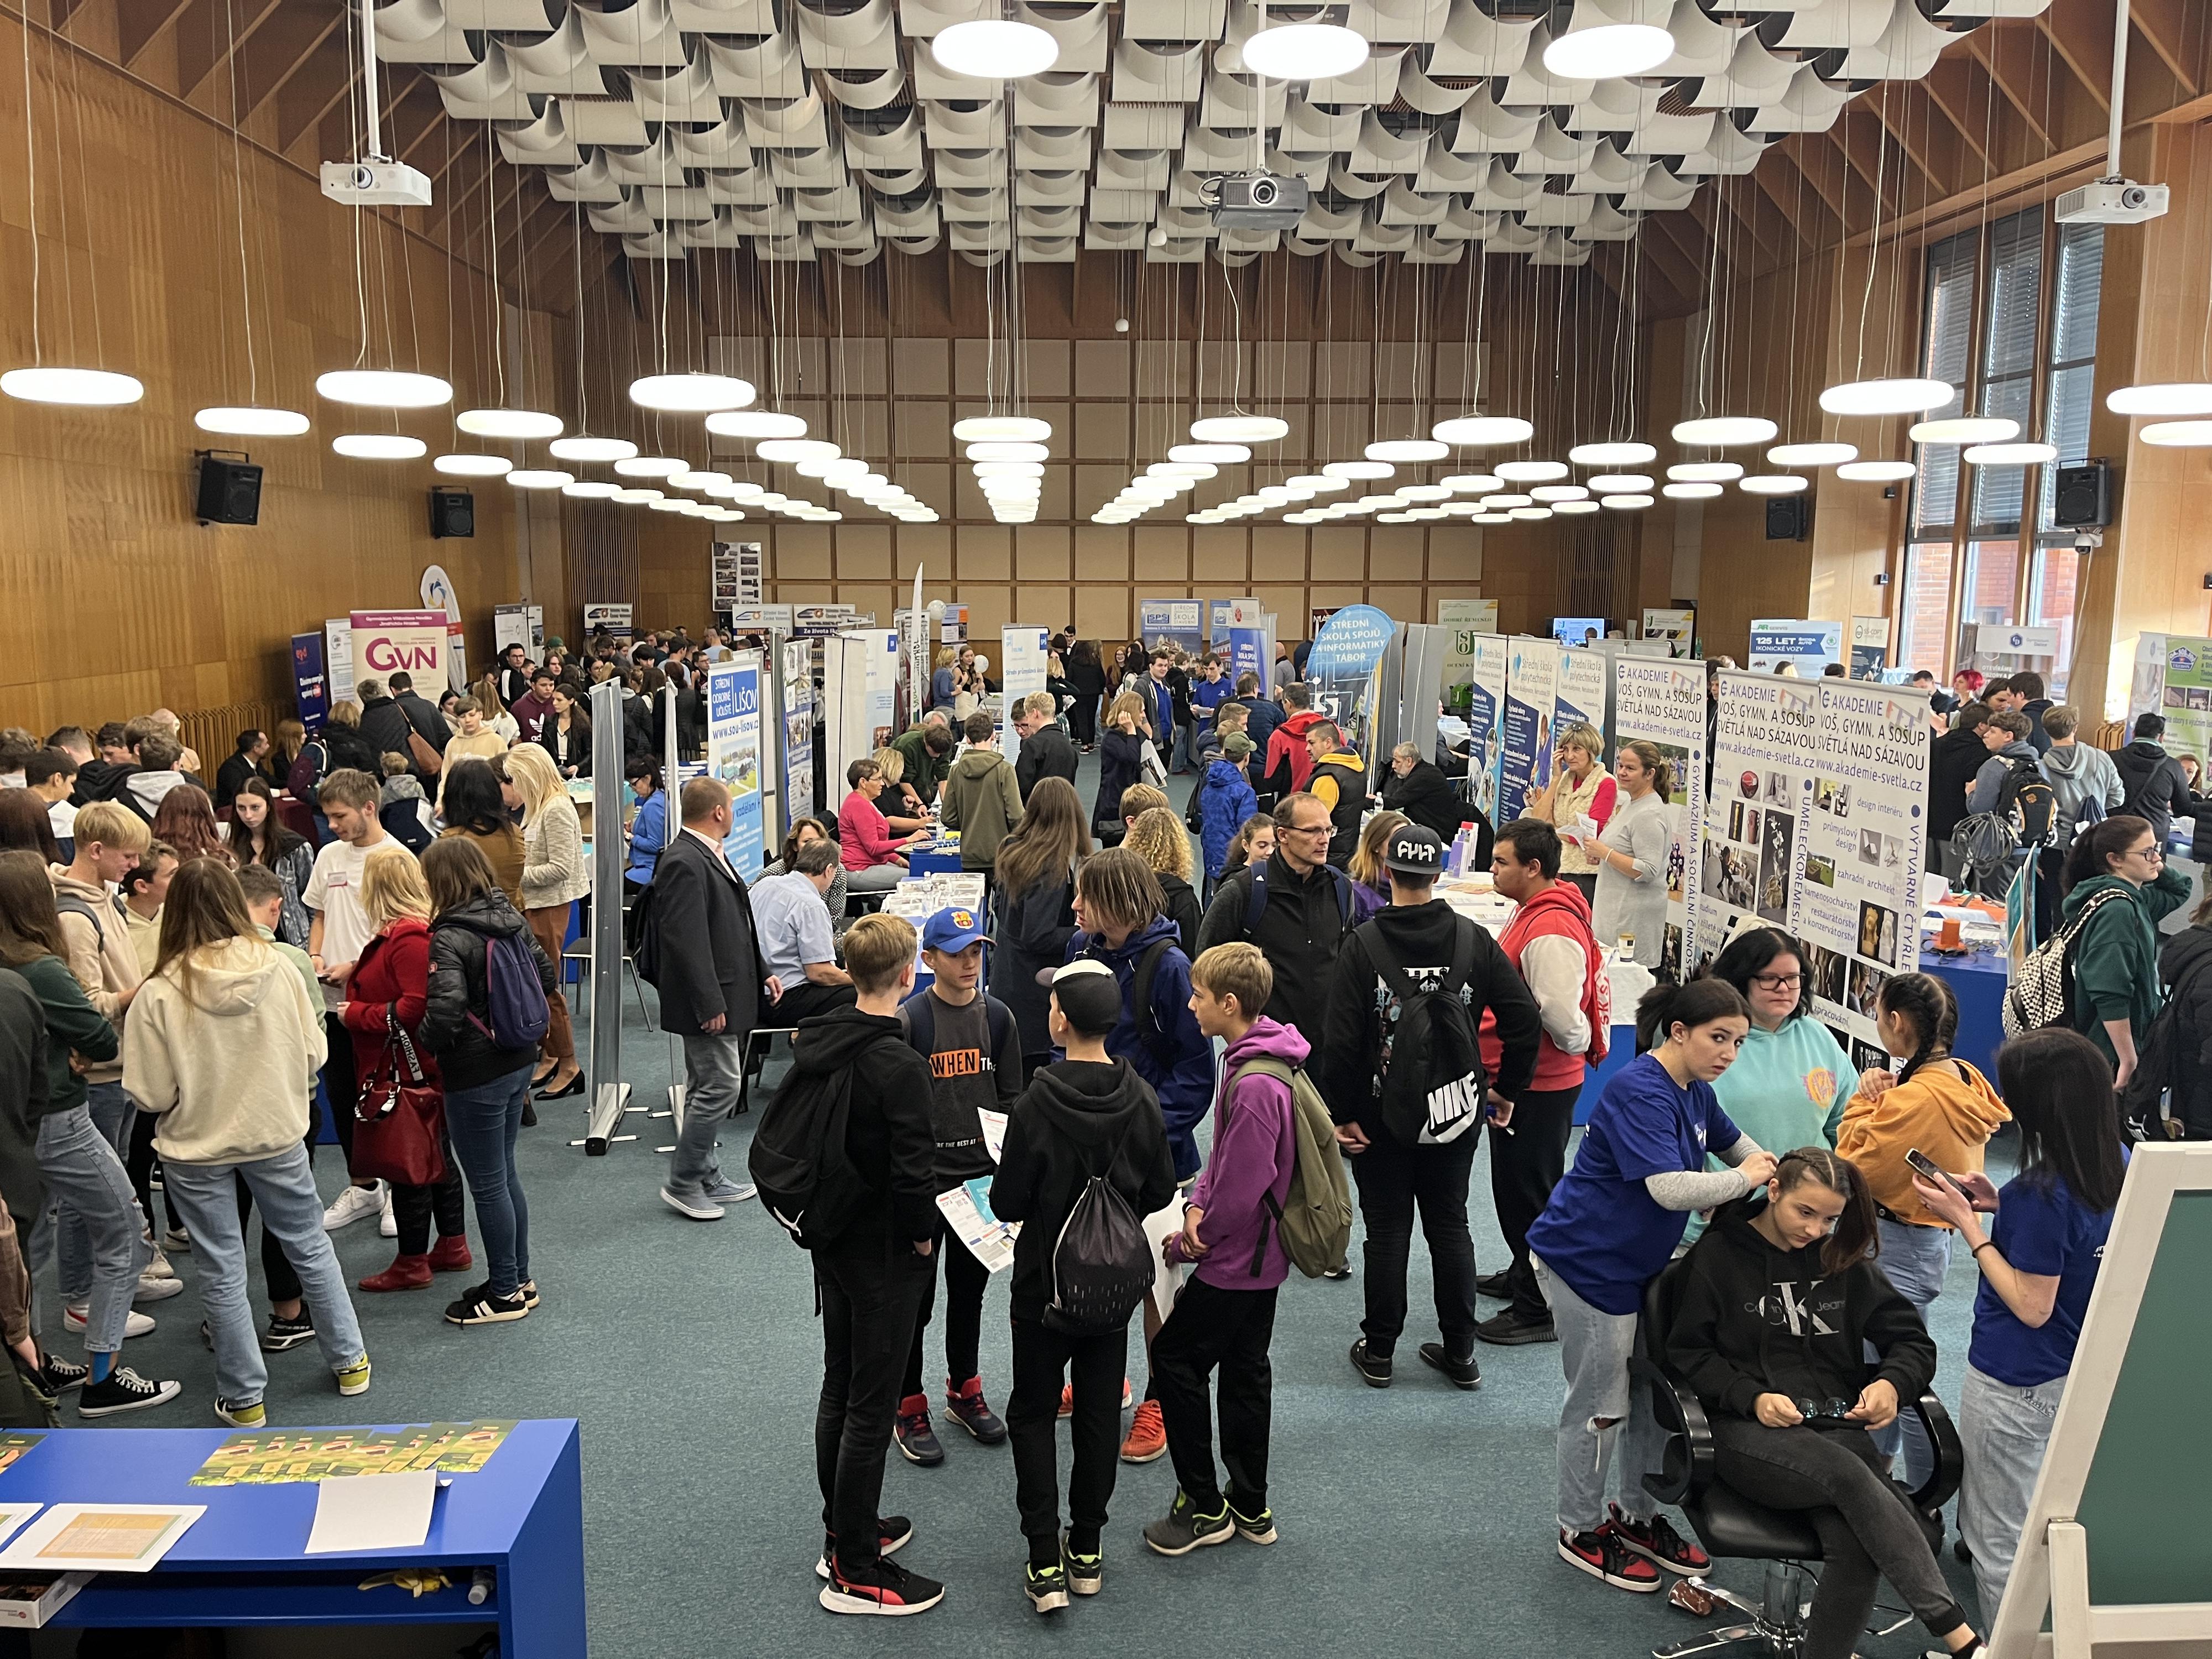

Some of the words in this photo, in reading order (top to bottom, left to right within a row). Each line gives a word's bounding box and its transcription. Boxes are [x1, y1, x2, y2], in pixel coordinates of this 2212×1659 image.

[1331, 618, 1369, 629] STŘEDNÍ
[1353, 628, 1380, 639] SPOJŮ
[365, 637, 436, 671] GVN
[1324, 639, 1385, 652] INFORMATIKY
[1335, 652, 1366, 662] TÁBOR
[1540, 660, 1552, 672] škola
[1587, 659, 1601, 671] škola
[714, 676, 731, 690] STŘEDNÍ
[1521, 671, 1551, 686] polytechnická
[1569, 670, 1600, 684] polytechnická
[1627, 667, 1668, 684] AKADEMIE
[712, 690, 731, 703] ODBORNÉ
[734, 686, 758, 713] LIŠOV
[1637, 686, 1662, 700] GYMN.
[1666, 690, 1671, 701] A
[1673, 688, 1702, 705] SOŠUP
[1730, 684, 1776, 702] AKADEMIE
[1617, 698, 1643, 714] SVĚTLÁ
[1645, 704, 1661, 717] NAD
[1663, 705, 1702, 723] SÁZAVOU
[1832, 695, 1883, 716] AKADEMIE
[1740, 705, 1767, 722] GYMN.
[1771, 710, 1778, 723] A
[1781, 710, 1815, 728] SOŠUP
[1617, 719, 1702, 740] www.akademie-svetla.cz
[1718, 718, 1745, 737] SVĚTLÁ
[1747, 726, 1765, 740] NAD
[1768, 727, 1815, 749] SÁZAVOU
[1843, 719, 1874, 738] GYMN.
[1878, 725, 1885, 740] A
[1889, 725, 1925, 747] SOŠUP
[1716, 741, 1815, 768] www.akademie-svetla.cz
[1818, 734, 1848, 755] SVĚTLÁ
[1851, 742, 1872, 759] NAD
[1875, 745, 1924, 771] SÁZAVOU
[1816, 759, 1922, 791] www.akademie-svetla.cz
[1690, 765, 1701, 842] GYMNÁZIUM
[1857, 797, 1876, 812] design
[1708, 823, 1725, 833] amene
[1823, 822, 1858, 839] průmyslový
[1835, 838, 1856, 852] design
[1905, 825, 1921, 909] VÝTVARNÉ
[1687, 859, 1697, 917] SOCIÁLNÍ
[1837, 870, 1865, 884] zahradní
[1867, 878, 1896, 895] architekt
[1804, 887, 1858, 912] kamenosochařství
[1811, 906, 1857, 930] restaurátorství
[1808, 919, 1856, 942] konzervátorství
[1901, 914, 1917, 972] ČTYŘLE
[1814, 1004, 1849, 1025] zpracování
[931, 1052, 975, 1075] WHEN
[1428, 1071, 1478, 1130] NIKE
